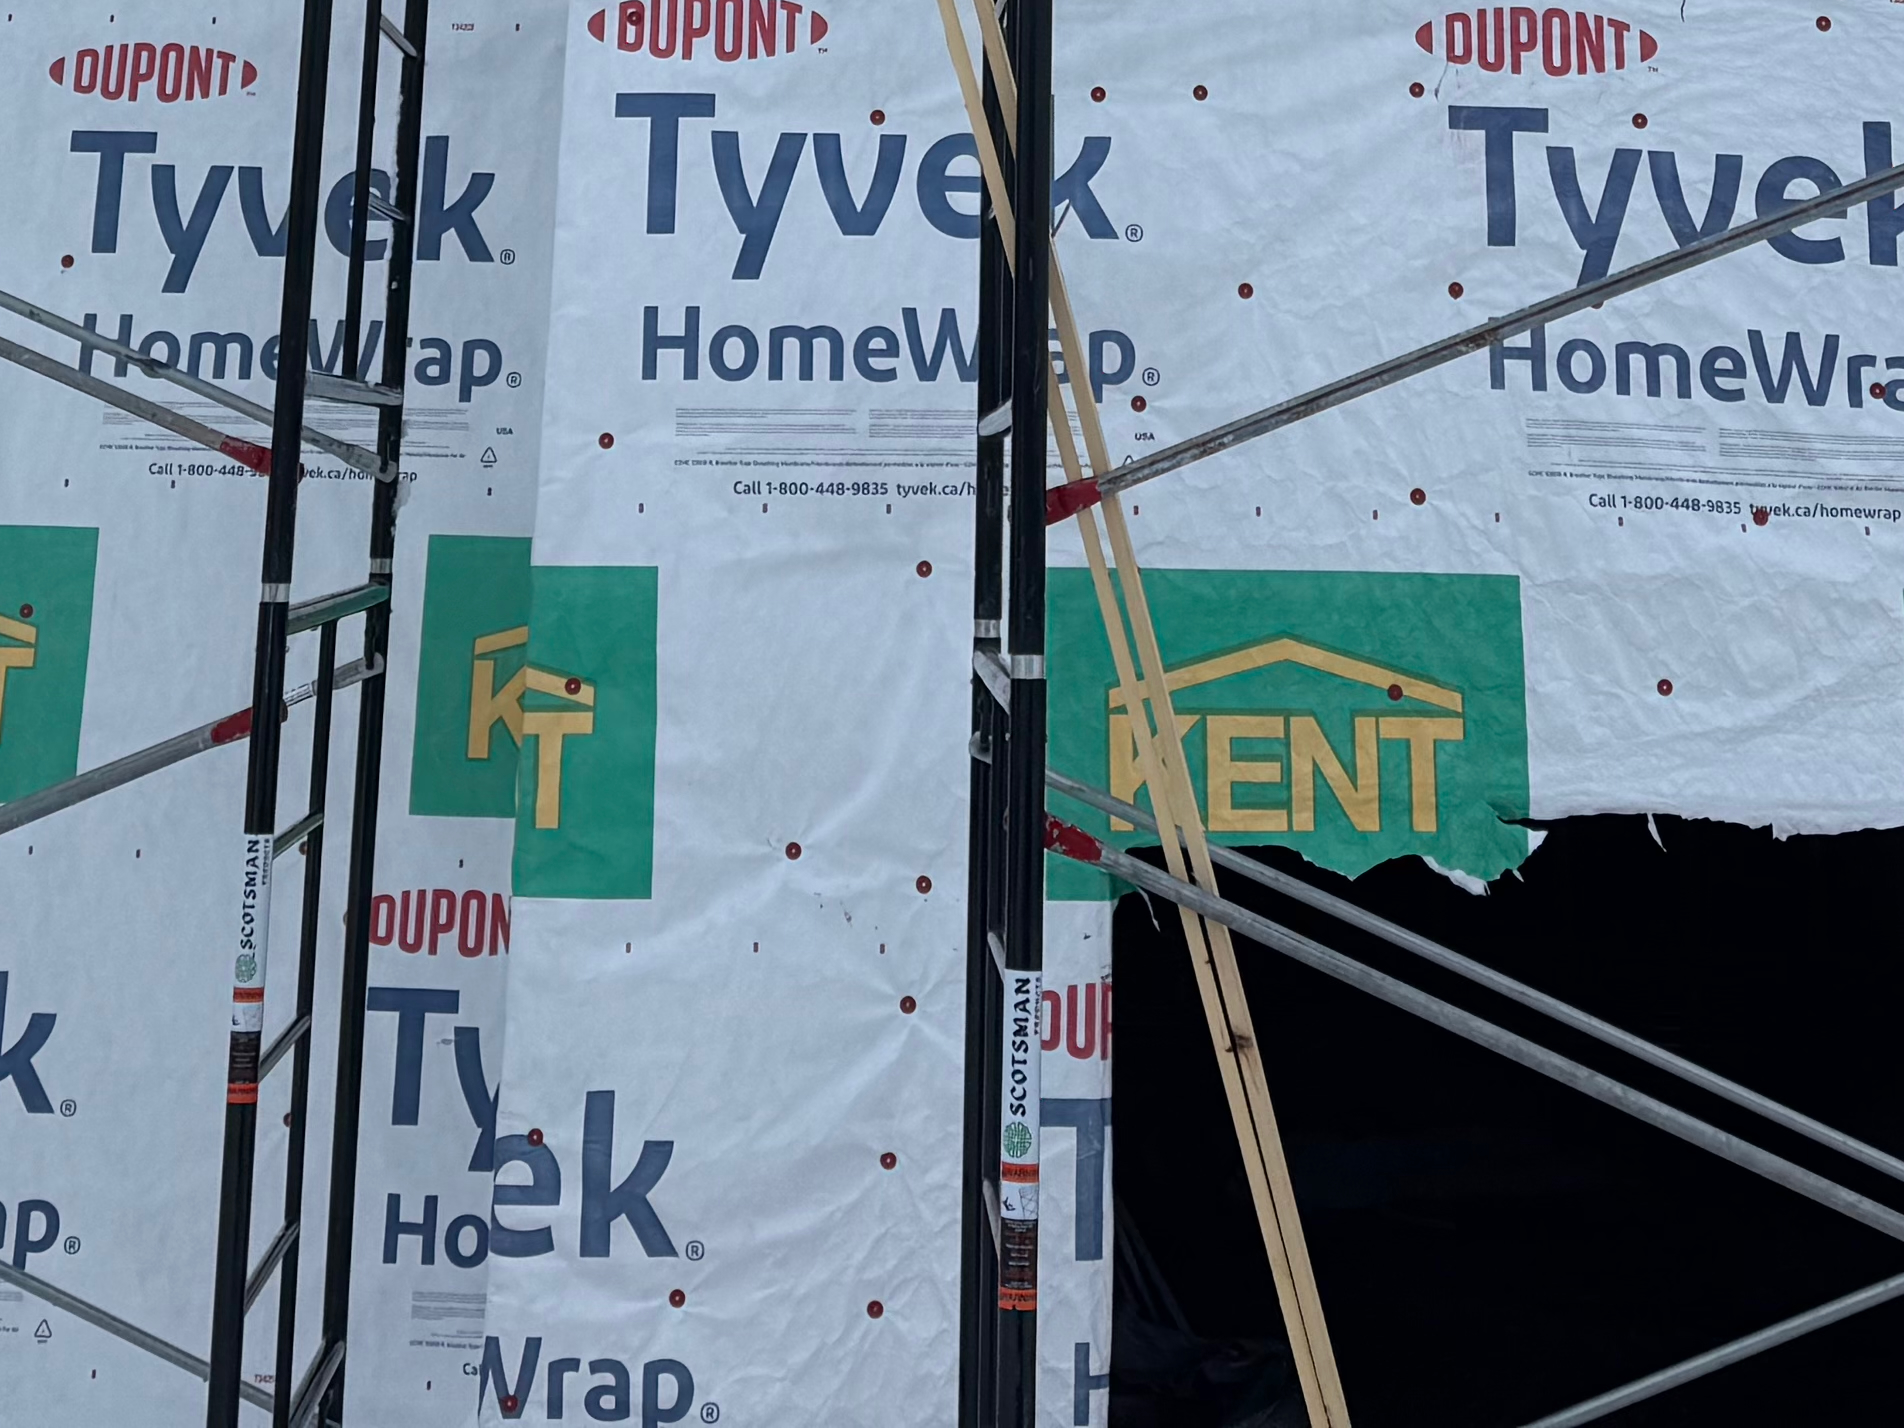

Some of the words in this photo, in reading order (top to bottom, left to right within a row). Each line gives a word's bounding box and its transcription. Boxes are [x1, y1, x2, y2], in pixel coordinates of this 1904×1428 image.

[73, 42, 237, 104] DUPONT
[1445, 6, 1632, 77] DUPONT
[148, 461, 173, 478] Call
[732, 480, 762, 496] Call
[765, 480, 889, 497] 1-800-448-9835
[1588, 492, 1617, 510] Call
[1620, 493, 1742, 516] 1-800-448-9835
[1108, 713, 1464, 833] KENT
[240, 839, 259, 949] SCOTSMAN
[1010, 977, 1032, 1117] SCOTSMAN
